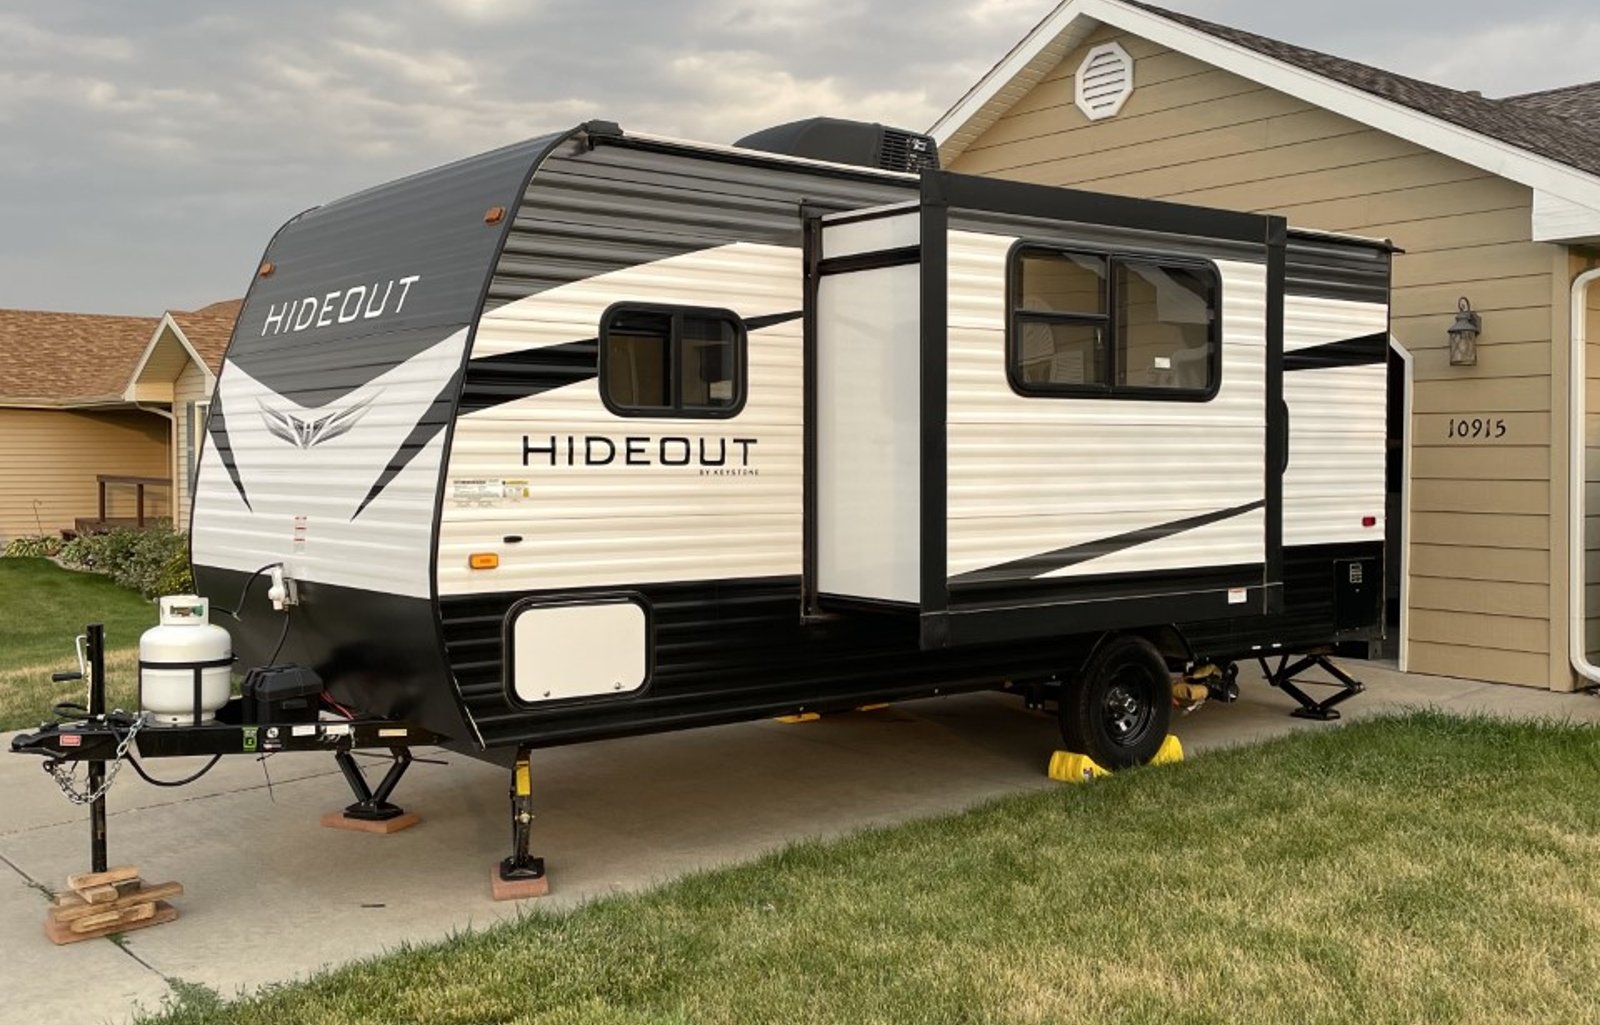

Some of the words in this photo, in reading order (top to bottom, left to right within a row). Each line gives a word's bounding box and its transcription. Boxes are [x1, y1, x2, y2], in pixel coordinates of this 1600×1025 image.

[261, 275, 421, 337] HIDEOUT
[1448, 418, 1506, 438] 10915
[522, 435, 758, 467] HIDEOUT
